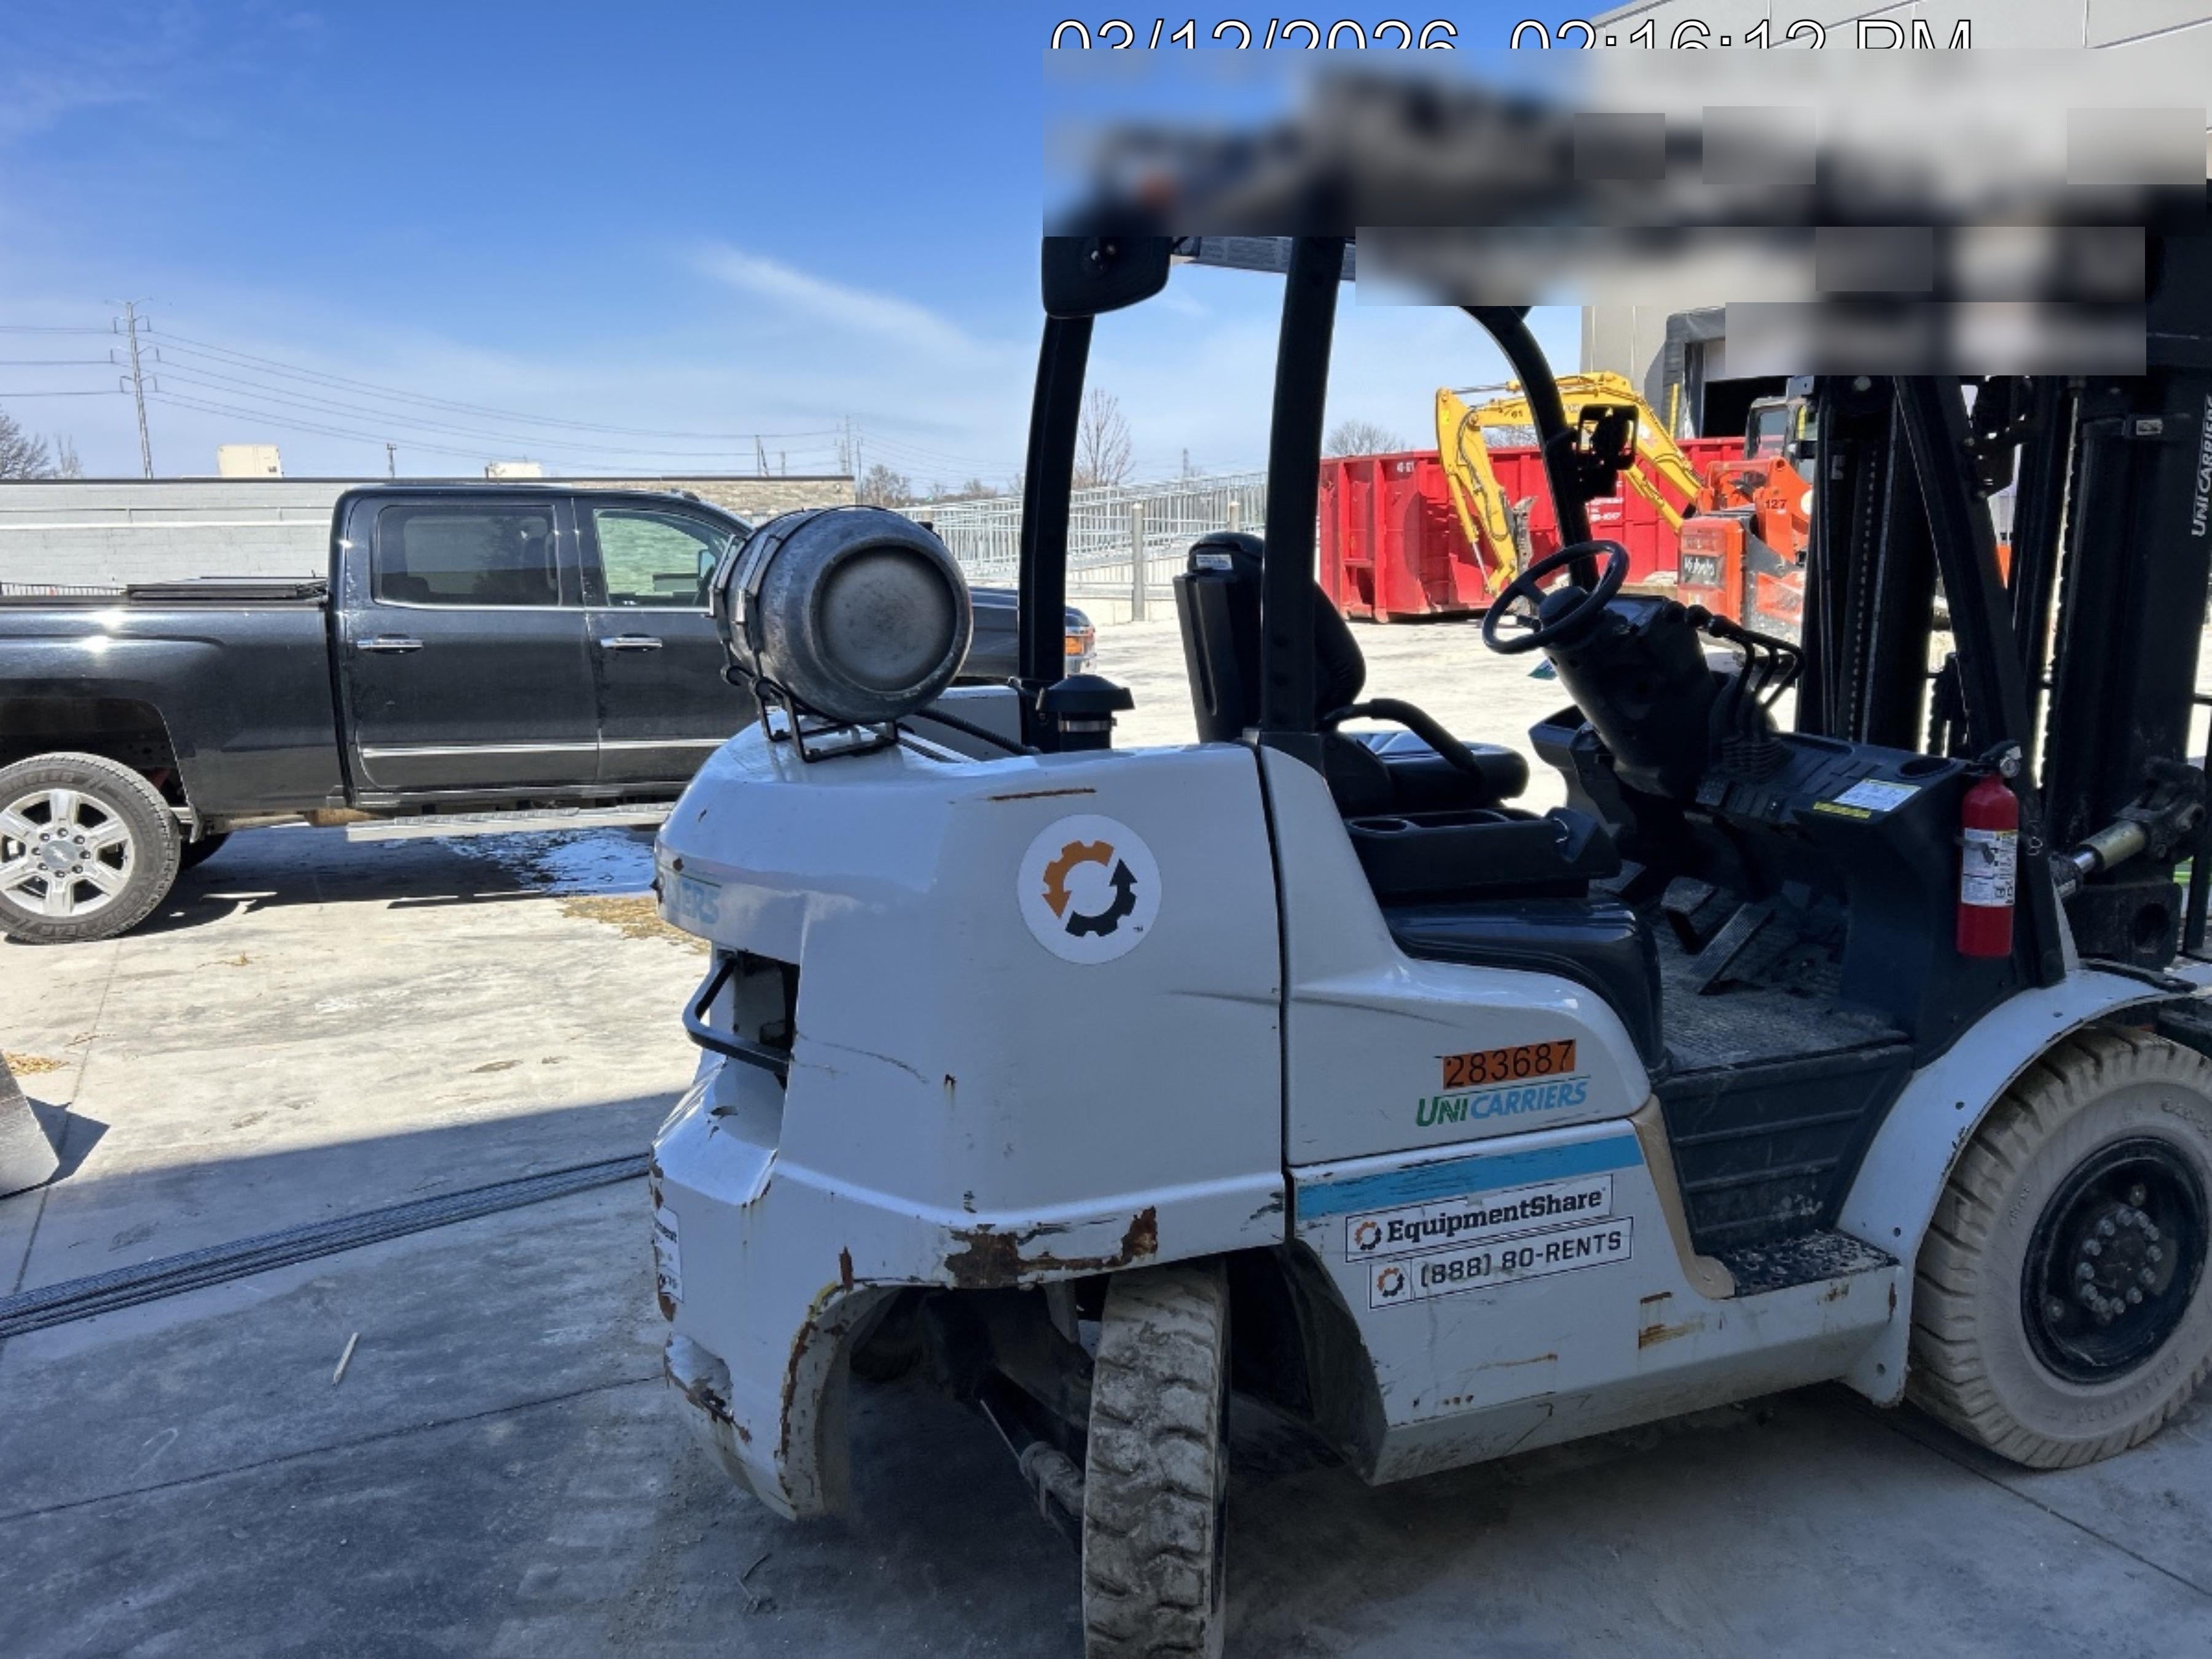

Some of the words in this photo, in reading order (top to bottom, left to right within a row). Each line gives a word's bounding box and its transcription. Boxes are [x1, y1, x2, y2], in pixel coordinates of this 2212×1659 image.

[1766, 499, 1786, 509] 127
[1446, 1039, 1574, 1088] 283687
[1416, 1081, 1588, 1127] UNICARRIERS
[1387, 1190, 1602, 1243] EquipmentShare
[1421, 1253, 1492, 1287] (888)
[1501, 1231, 1622, 1270] 80-RENTS
